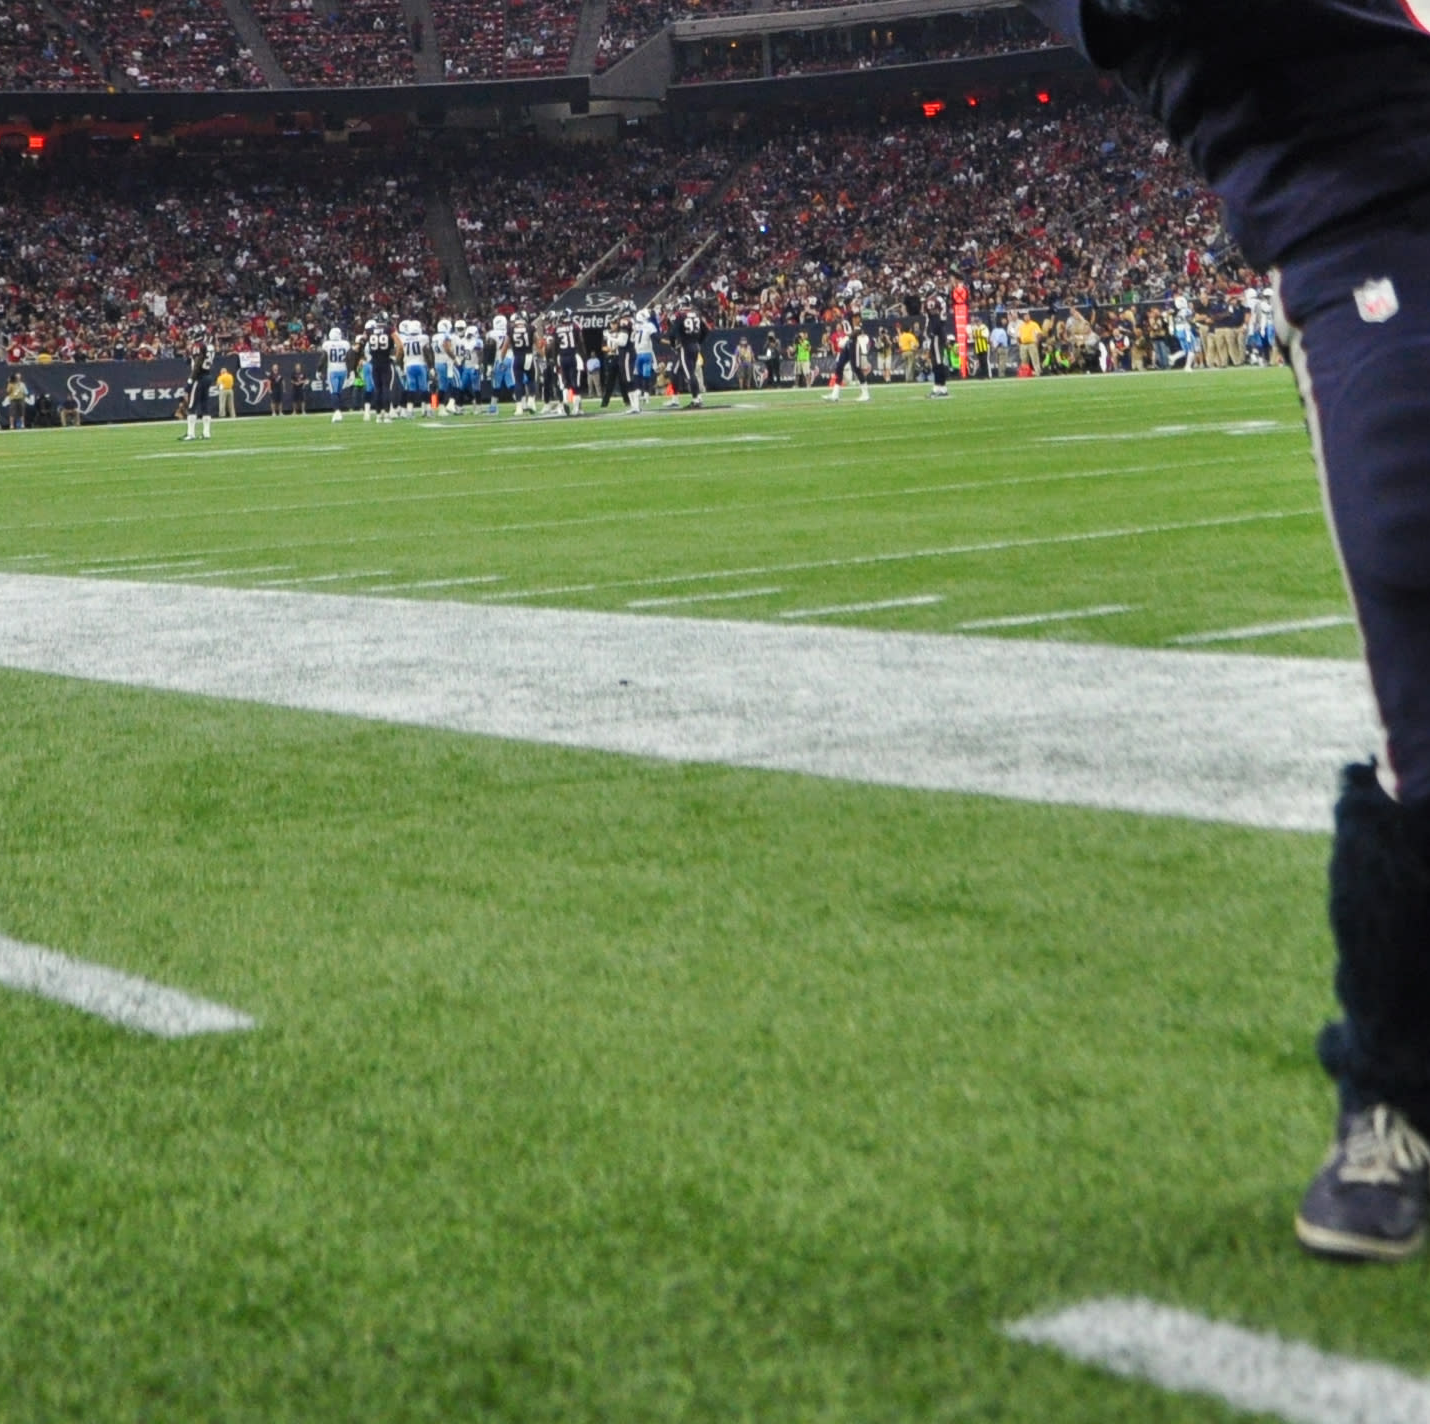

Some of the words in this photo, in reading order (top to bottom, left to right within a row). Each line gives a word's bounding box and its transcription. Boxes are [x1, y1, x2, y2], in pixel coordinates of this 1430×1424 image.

[683, 317, 700, 334] 93
[370, 334, 388, 350] 99
[404, 341, 421, 356] 70
[513, 333, 529, 348] 51
[559, 332, 575, 349] 31
[330, 347, 346, 363] 82
[123, 385, 220, 400] TEXAS
